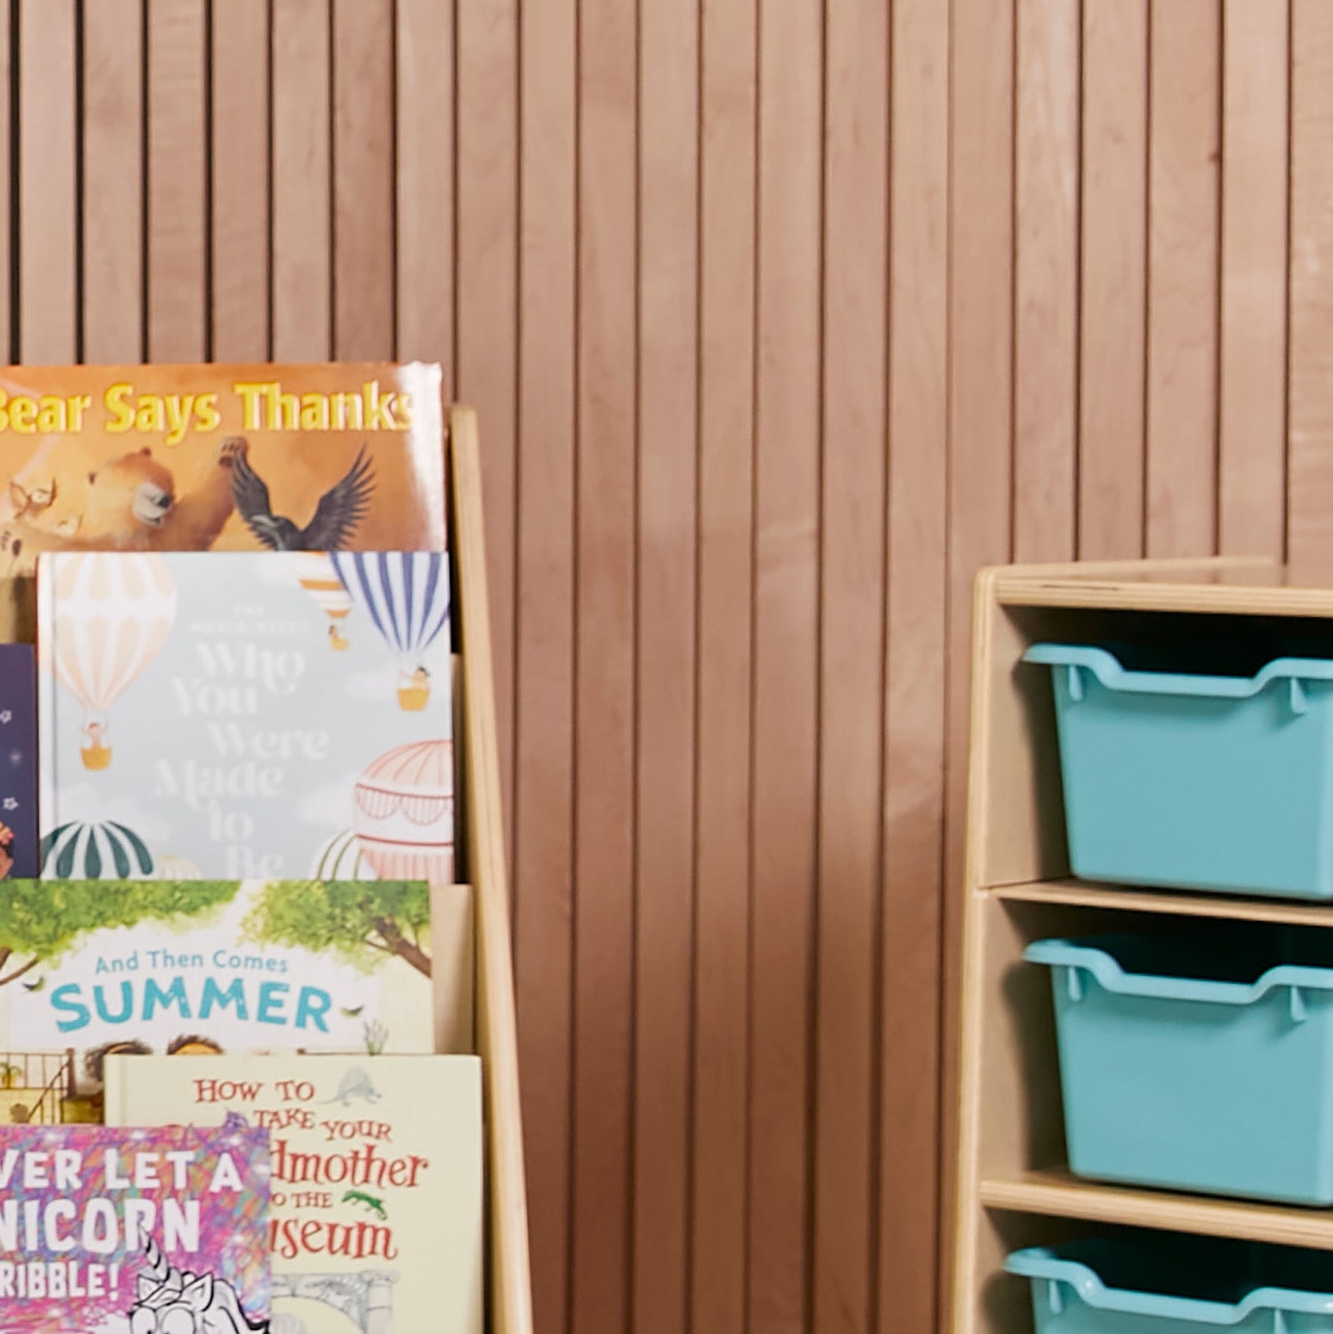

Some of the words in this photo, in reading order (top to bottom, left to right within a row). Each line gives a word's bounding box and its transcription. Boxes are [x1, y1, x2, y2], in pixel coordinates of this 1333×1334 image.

[104, 381, 222, 447] Says
[233, 380, 414, 432] Thanks
[169, 676, 259, 716] You
[206, 721, 330, 760] Were
[94, 950, 139, 975] And
[146, 947, 205, 968] Then
[212, 949, 289, 974] Comes
[49, 975, 332, 1034] SUMMER
[275, 1080, 316, 1102] TO
[253, 1108, 316, 1130] TAKE
[321, 1119, 393, 1143] YOUR
[103, 1147, 196, 1190] LET
[208, 1152, 245, 1193] A
[270, 1138, 429, 1190] dmother
[291, 1192, 334, 1209] THE
